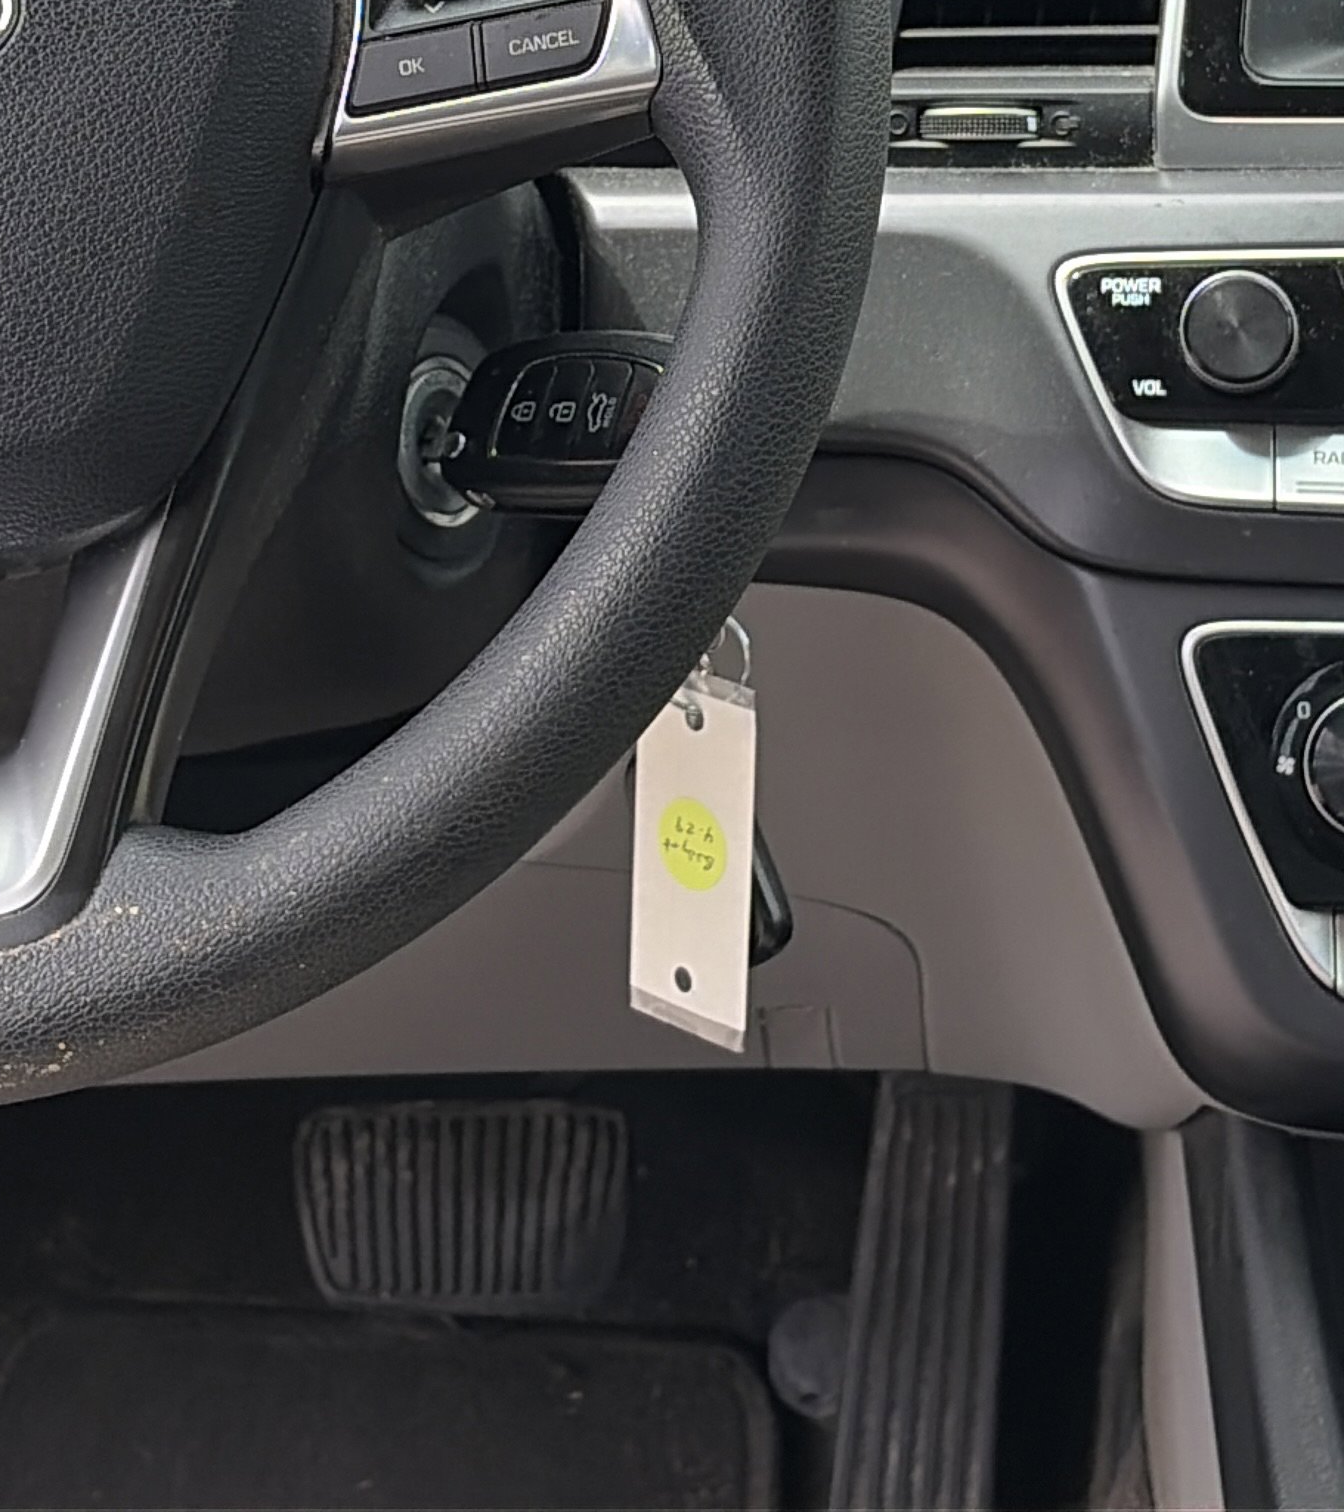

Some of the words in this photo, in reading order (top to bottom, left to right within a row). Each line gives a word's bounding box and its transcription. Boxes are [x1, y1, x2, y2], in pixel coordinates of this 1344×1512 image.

[508, 31, 580, 56] CANCEL
[398, 57, 424, 76] OK
[1101, 277, 1162, 293] POWER
[1112, 294, 1151, 306] PUSH
[1132, 380, 1167, 396] VOL
[1295, 700, 1312, 721] 0
